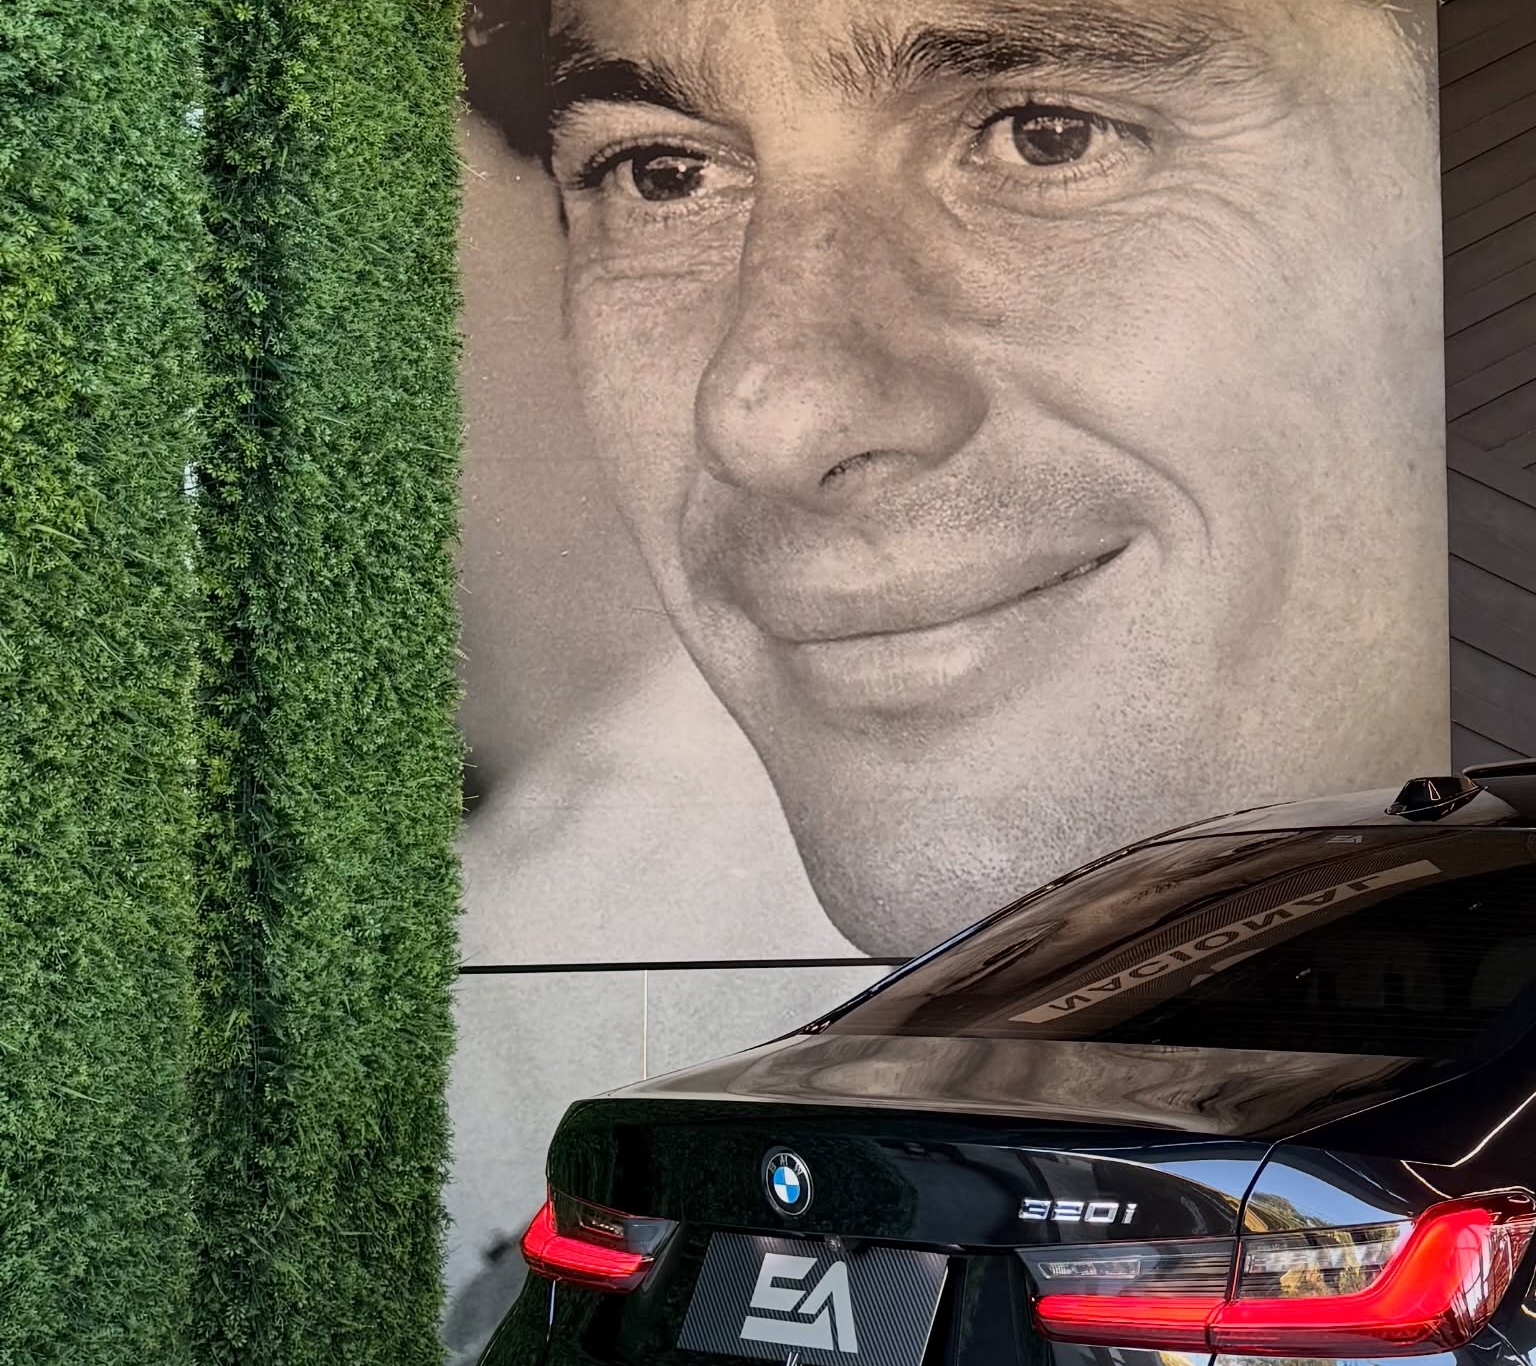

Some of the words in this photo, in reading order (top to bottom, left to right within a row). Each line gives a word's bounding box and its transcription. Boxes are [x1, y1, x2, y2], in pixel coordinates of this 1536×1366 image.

[768, 1154, 804, 1176] BMW
[1018, 1198, 1138, 1224] 320i
[739, 1252, 858, 1354] EA
